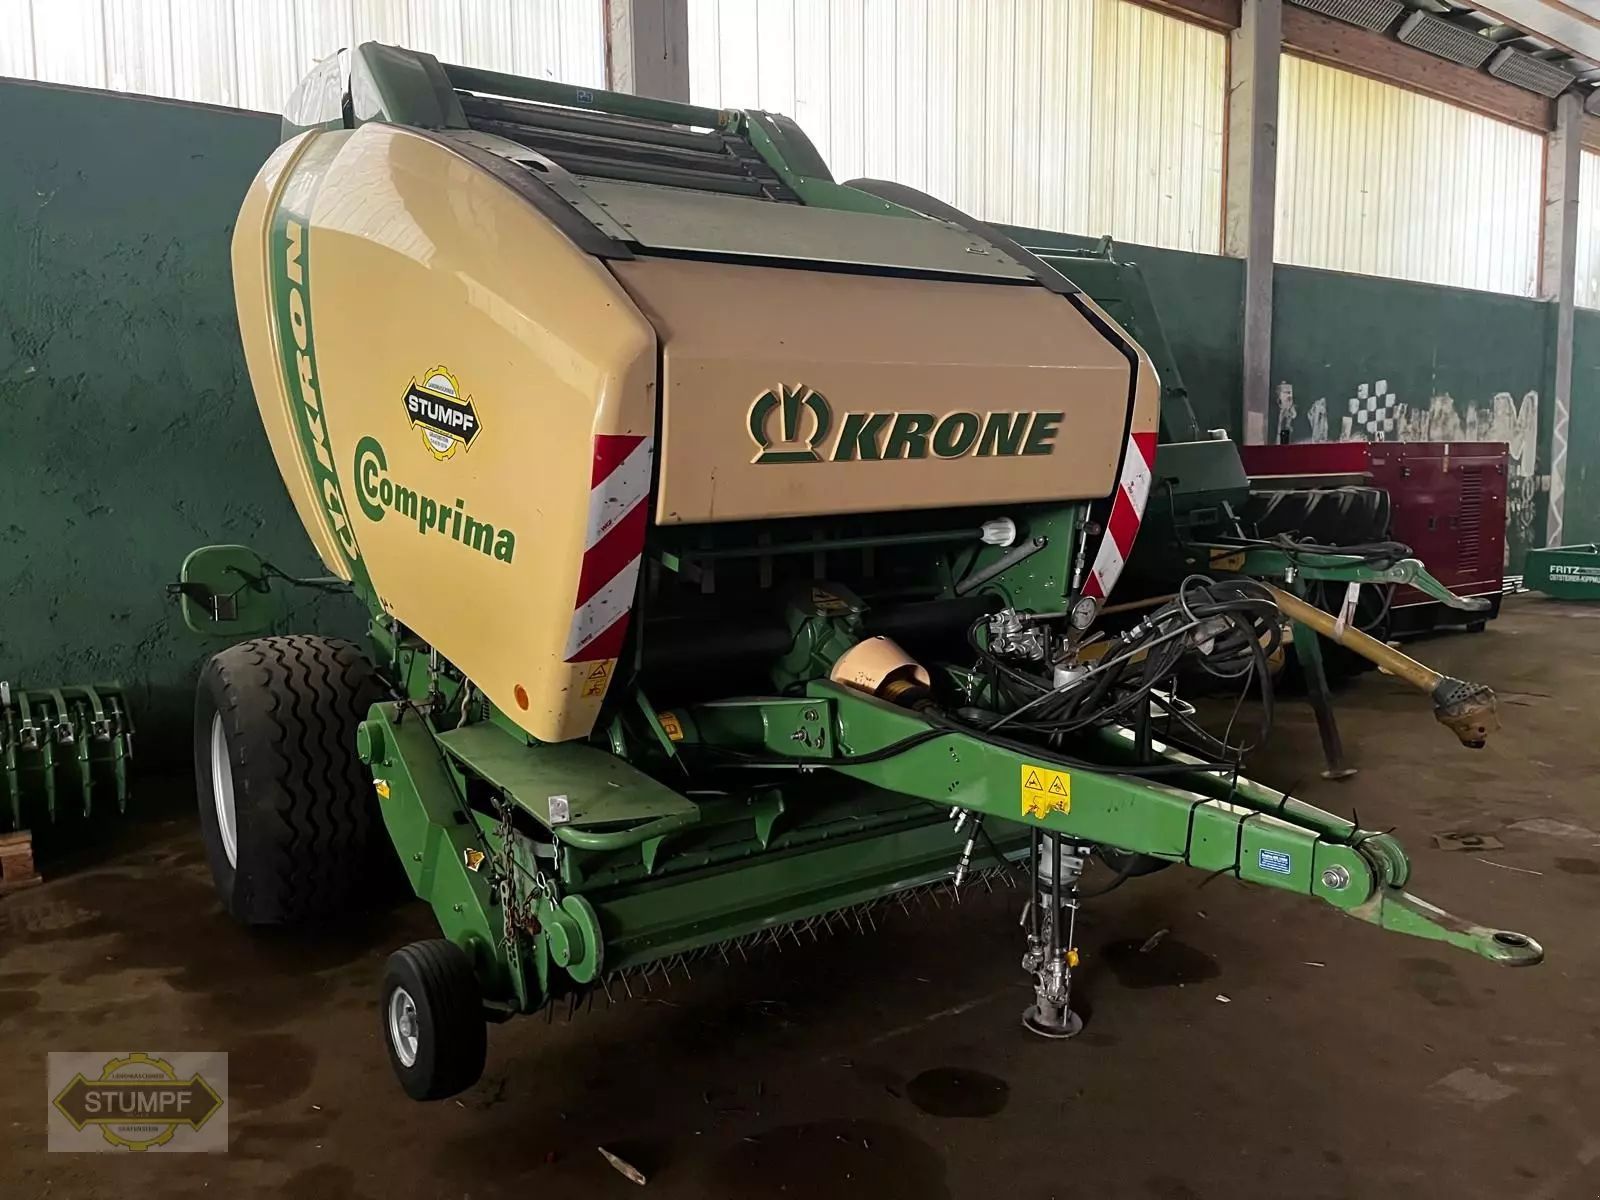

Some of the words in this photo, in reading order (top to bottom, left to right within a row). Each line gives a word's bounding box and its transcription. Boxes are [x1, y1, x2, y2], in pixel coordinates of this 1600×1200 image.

[284, 200, 334, 472] KRON
[408, 394, 474, 431] STUMPF
[829, 411, 1065, 461] KRONE
[354, 436, 516, 564] Comprima
[1550, 565, 1580, 574] FRITZ
